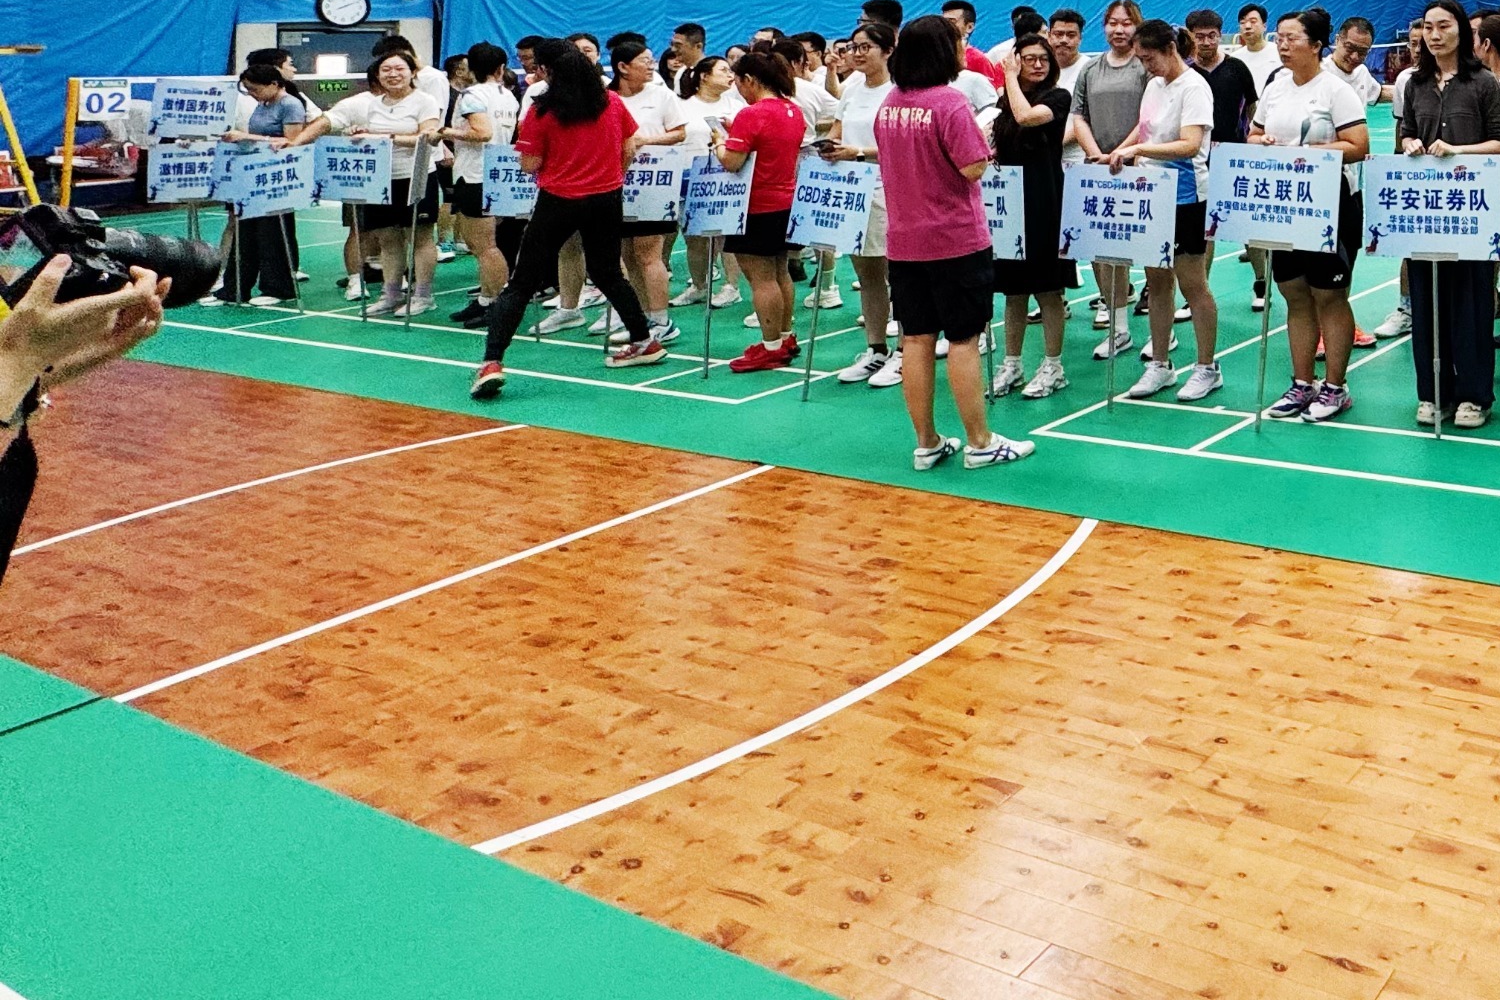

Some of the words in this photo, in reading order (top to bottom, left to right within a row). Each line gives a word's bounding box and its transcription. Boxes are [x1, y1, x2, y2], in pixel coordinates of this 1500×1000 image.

[85, 92, 126, 114] 02
[910, 107, 932, 124] ERA
[326, 157, 376, 174] 羽众不同
[255, 168, 299, 187] 邦邦队
[690, 181, 717, 197] FESCO
[717, 180, 746, 196] Adecco
[1233, 175, 1313, 203] 信达联队
[797, 185, 866, 213] CBD凌云羽队
[1083, 195, 1153, 221] 城发二队
[1378, 187, 1490, 211] 华安证券队
[1216, 199, 1331, 219] 中国信达资产管理股份有限公司
[1251, 212, 1292, 225] 山东分公司
[1389, 214, 1478, 225] 华安证券股份有限公司
[1103, 231, 1131, 241] 有限公司
[1388, 224, 1479, 235] 济南经十路证券营业部
